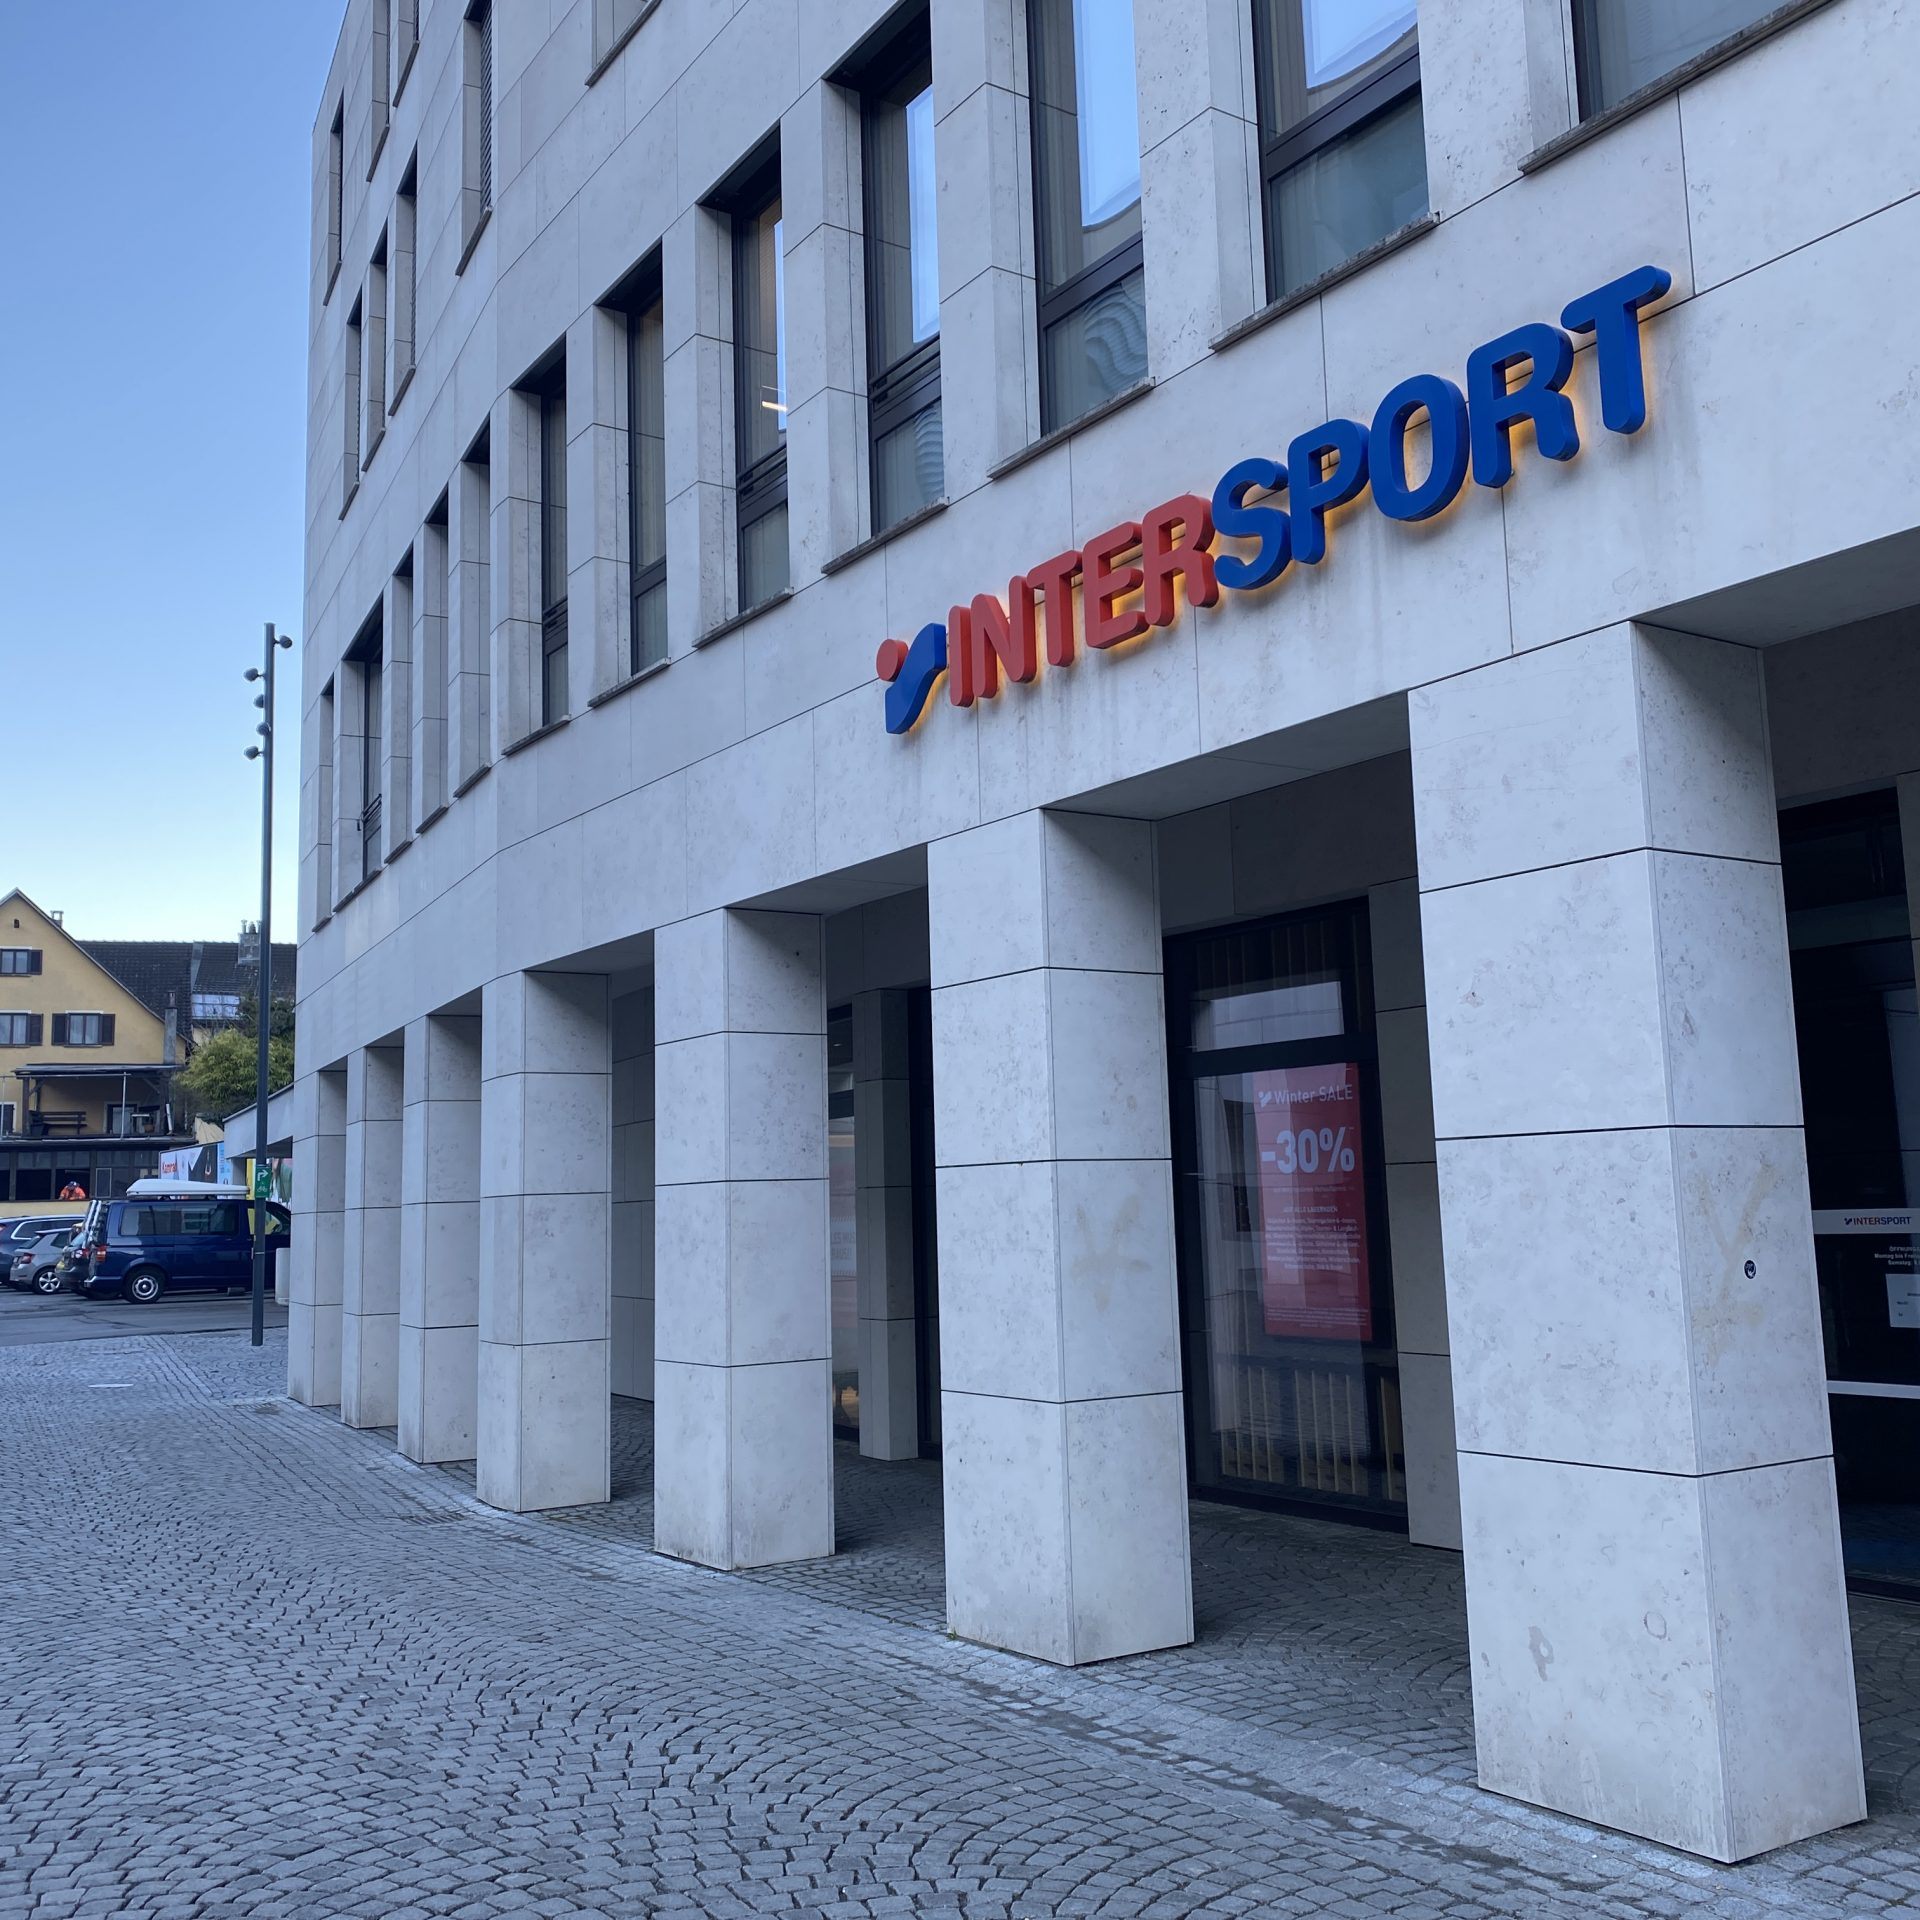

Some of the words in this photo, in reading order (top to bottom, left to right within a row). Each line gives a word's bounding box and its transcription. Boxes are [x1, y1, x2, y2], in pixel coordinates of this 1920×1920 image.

[948, 264, 1672, 708] INTERSPORT
[1273, 1090, 1316, 1105] Winter
[1319, 1084, 1353, 1102] SALE
[1261, 1127, 1355, 1174] -30%
[1853, 1216, 1912, 1225] INTERSPORT
